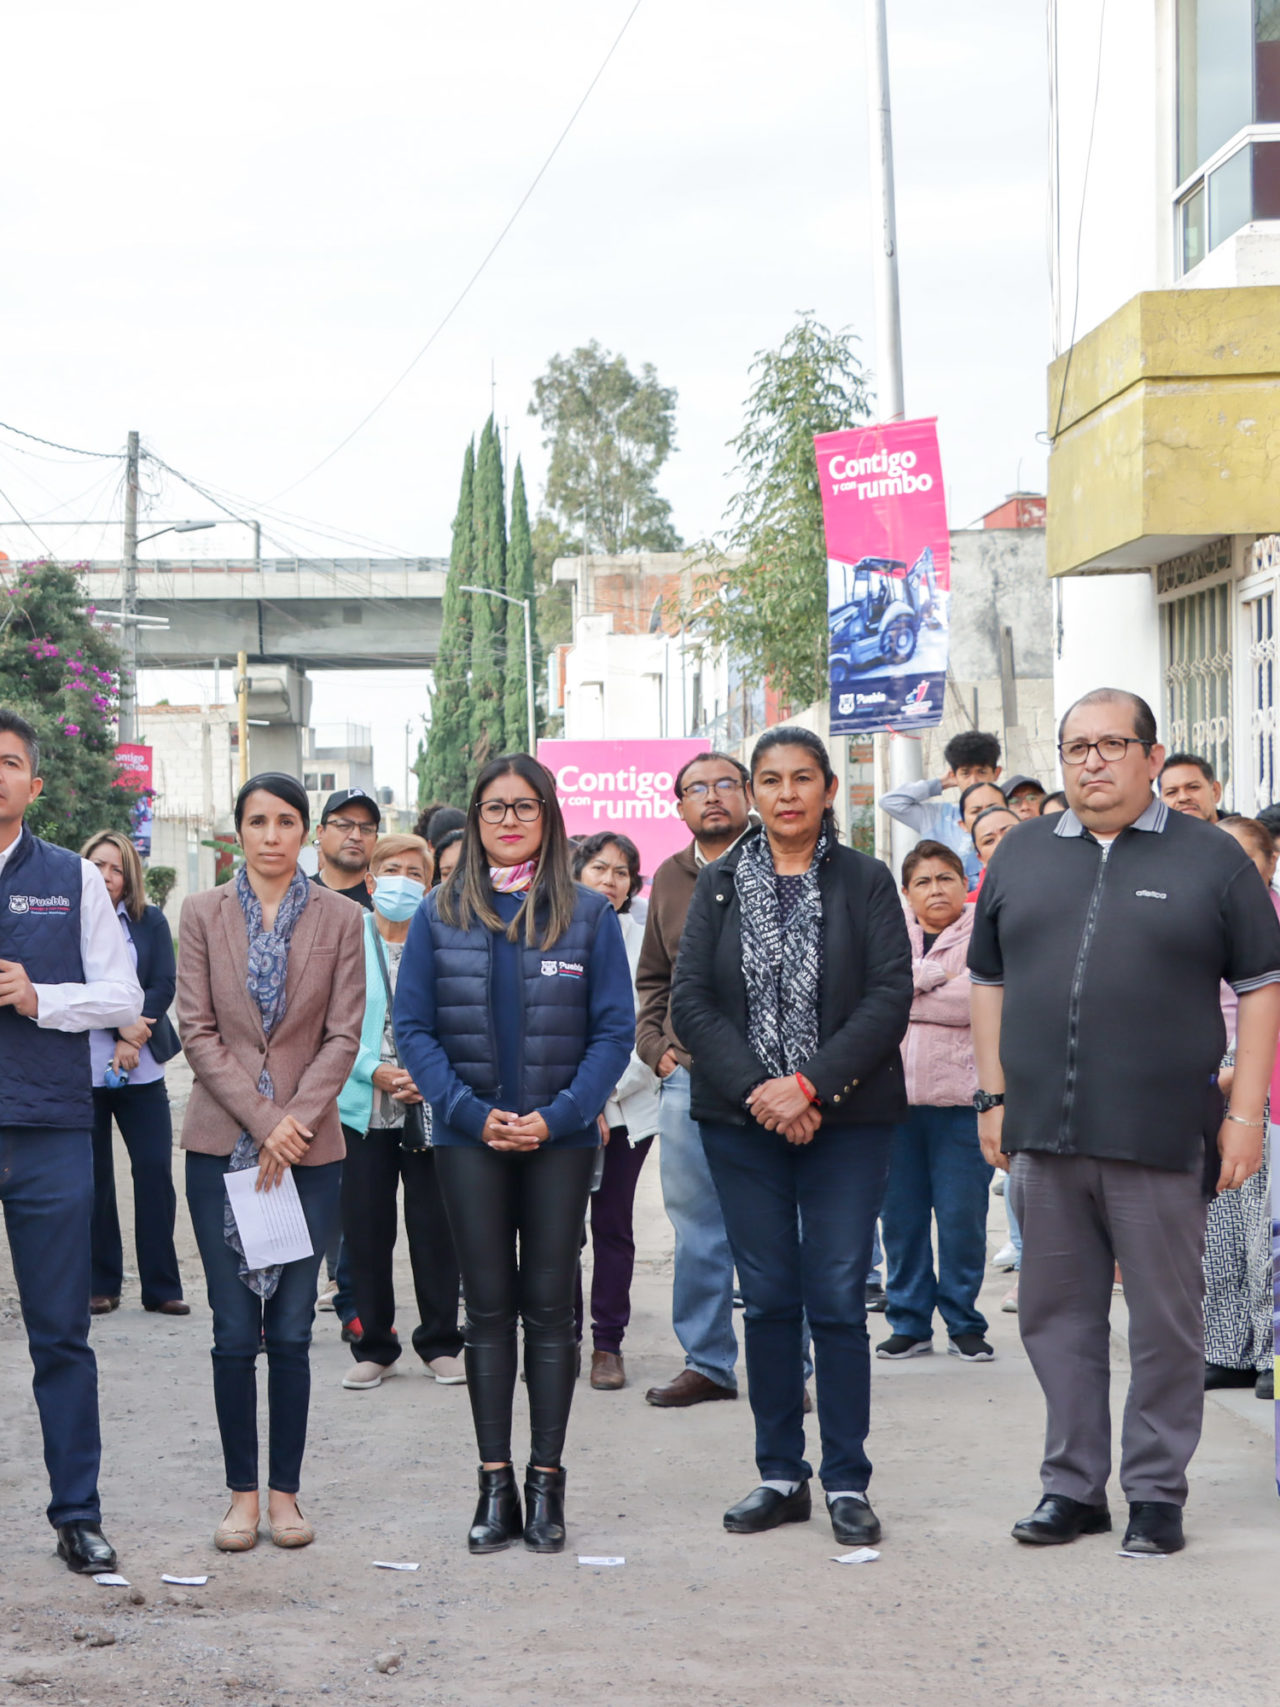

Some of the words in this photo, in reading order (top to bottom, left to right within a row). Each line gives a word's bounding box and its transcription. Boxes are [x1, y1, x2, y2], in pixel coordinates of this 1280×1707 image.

[828, 448, 917, 480] Contigo
[832, 484, 839, 496] y
[858, 470, 933, 500] rumbo
[115, 752, 144, 765] ontigo
[557, 765, 673, 799] Contigo
[568, 796, 591, 806] con
[29, 896, 70, 906] Puebla
